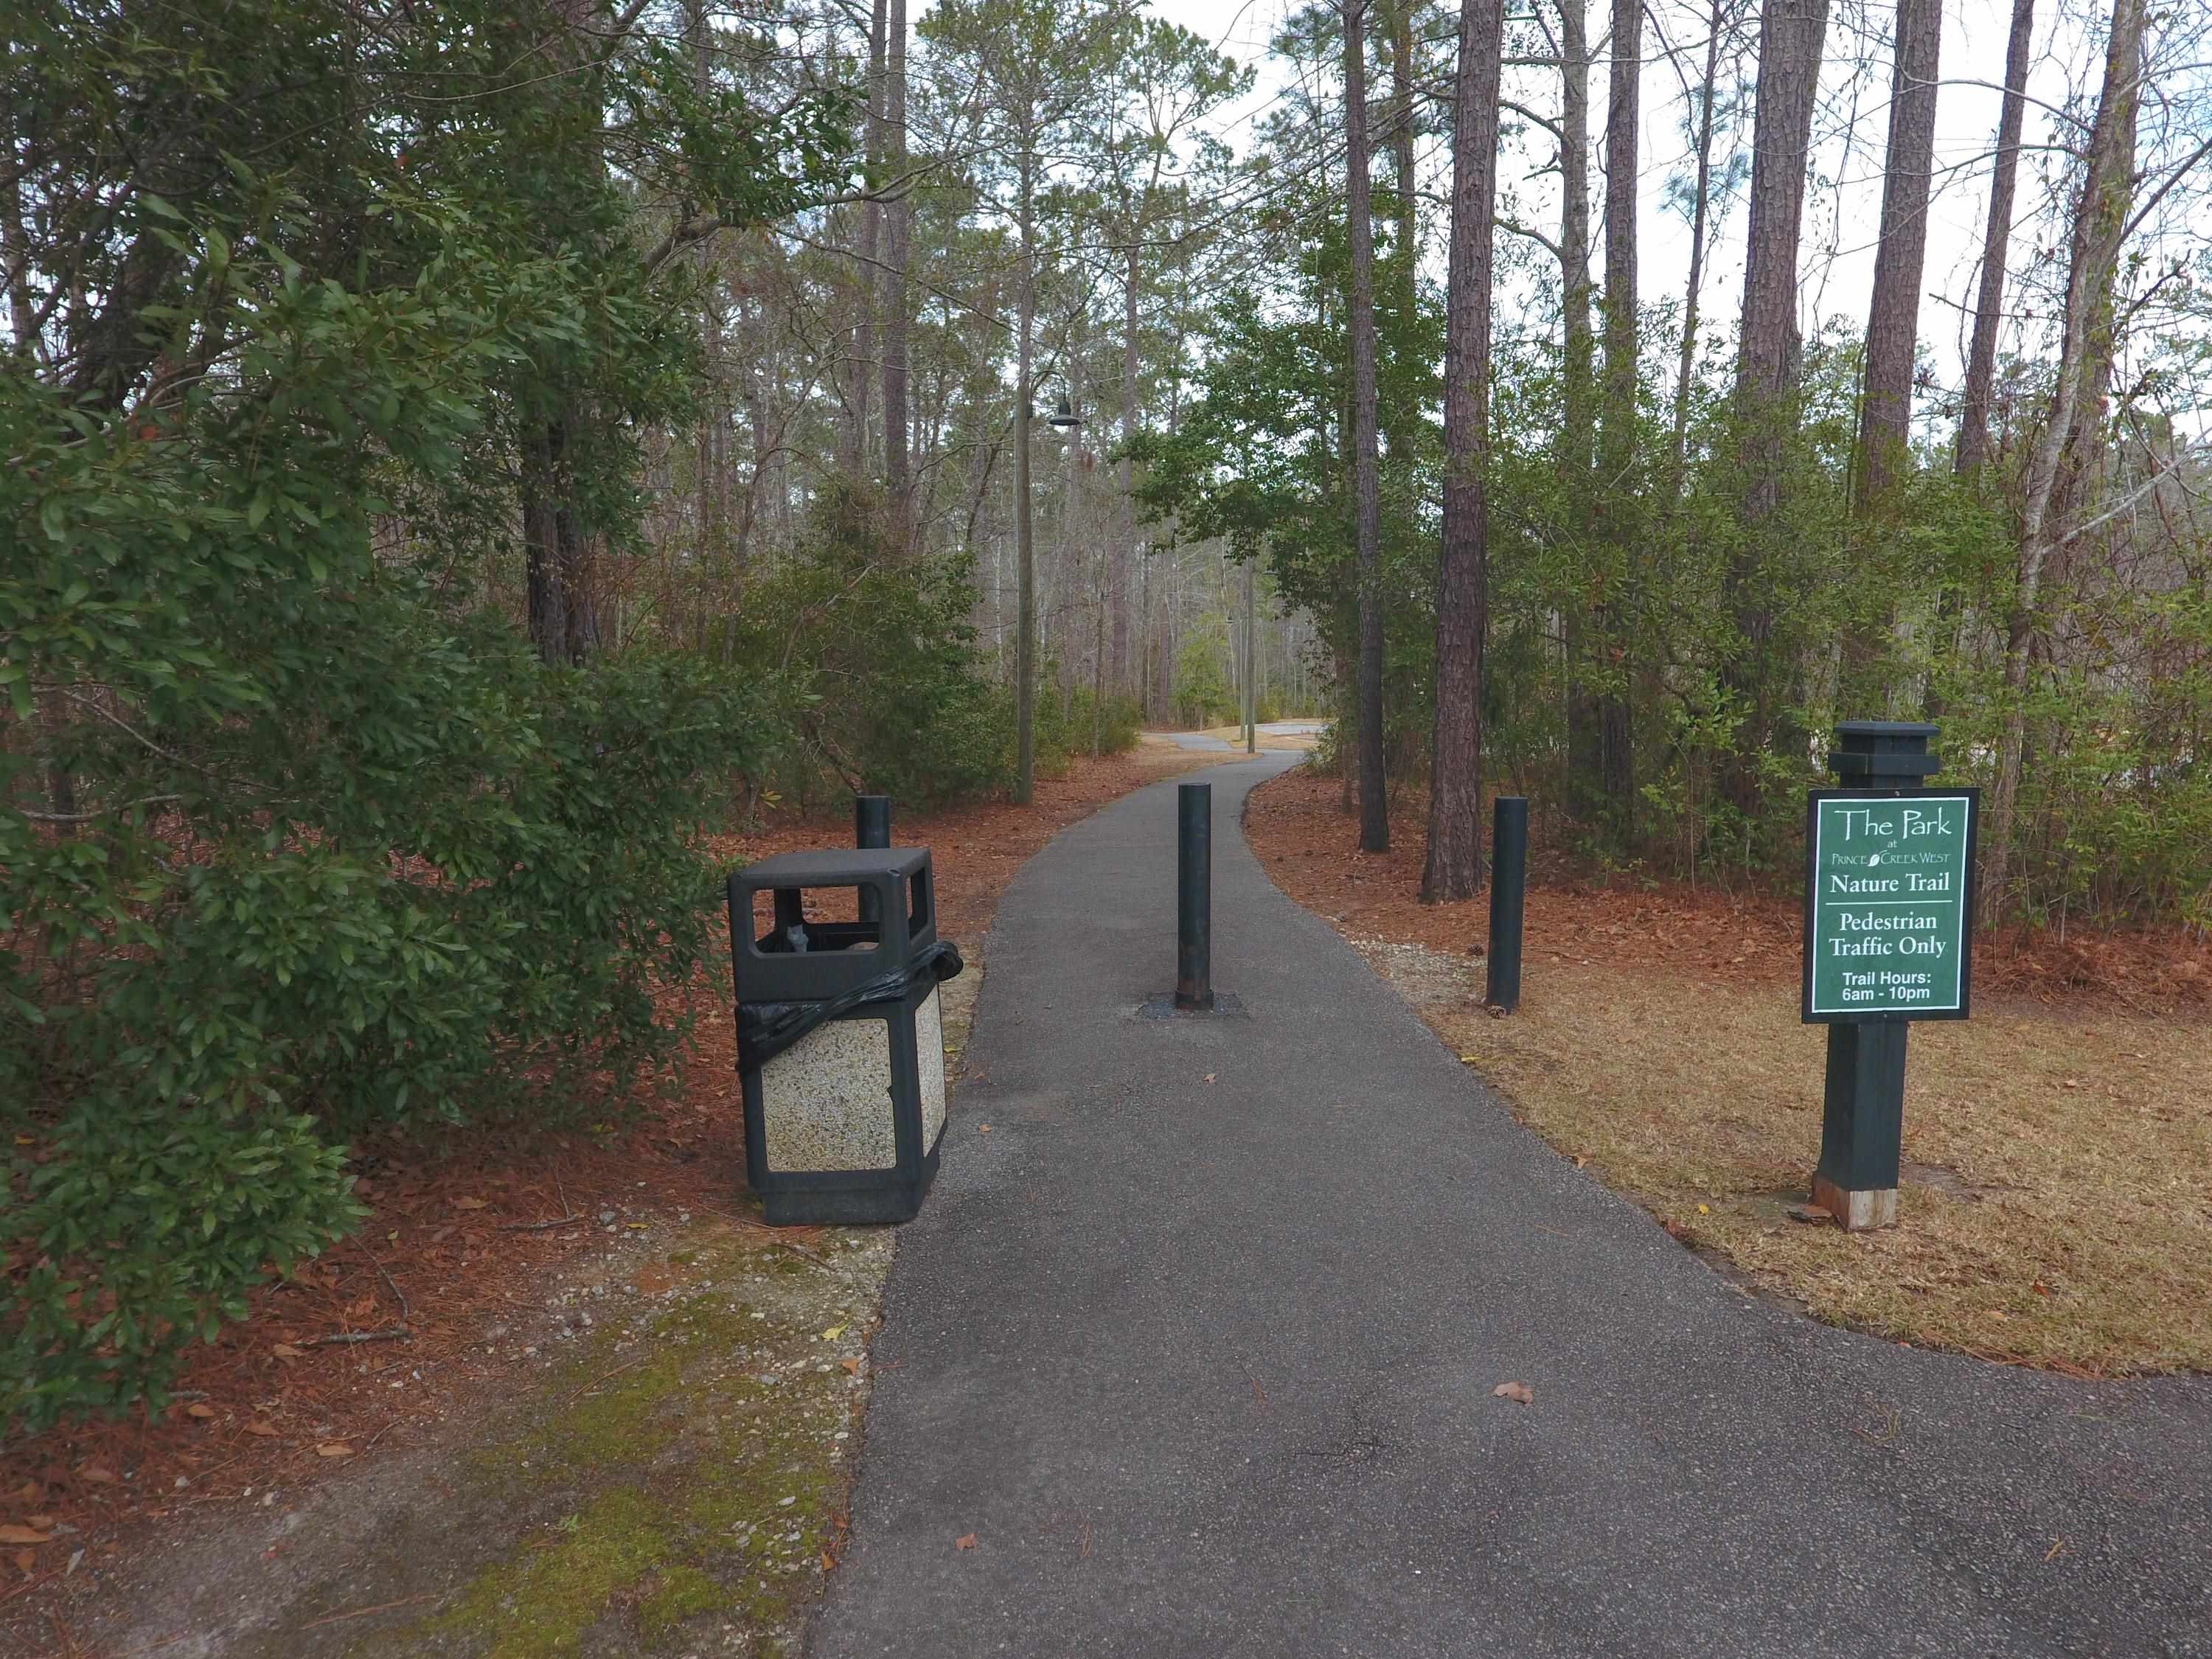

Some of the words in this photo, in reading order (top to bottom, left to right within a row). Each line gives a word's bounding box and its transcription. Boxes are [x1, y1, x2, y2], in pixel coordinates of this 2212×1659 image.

[1834, 809, 1893, 841] The
[1902, 807, 1952, 839] Park
[1887, 839, 1898, 848] at
[1832, 853, 1868, 865] PRINCE
[1879, 850, 1918, 865] CREEK
[1919, 852, 1951, 863] WEST
[1830, 874, 1899, 893] Nature
[1905, 872, 1950, 891] Trail
[1840, 911, 1938, 931] Pedestrian
[1829, 936, 1893, 956] Traffic
[1899, 936, 1947, 959] Only
[1843, 972, 1875, 985] Trail
[1880, 971, 1931, 984] Hours:
[1843, 988, 1874, 1001] 6am
[1889, 987, 1930, 1002] 10pm
